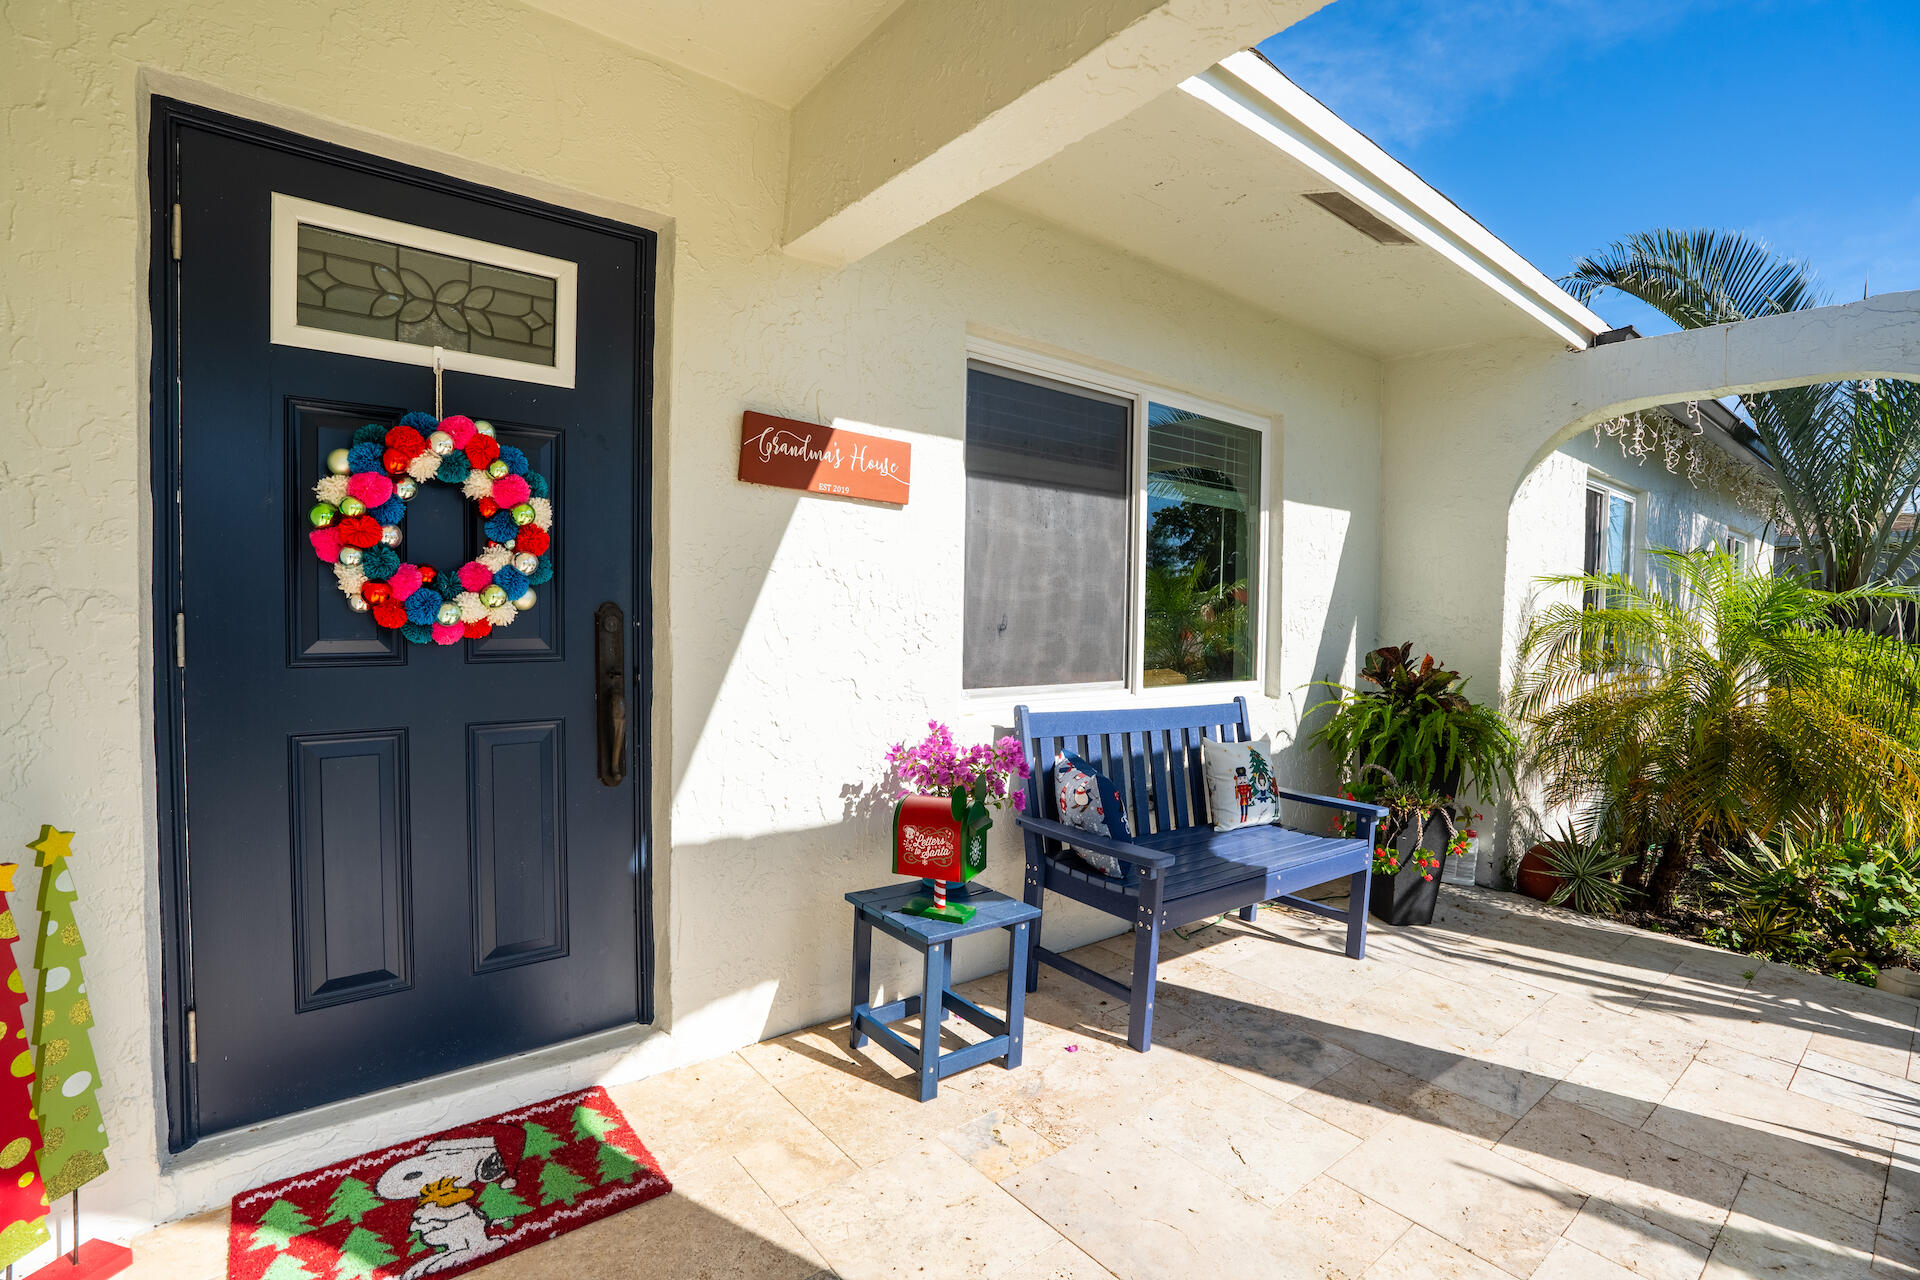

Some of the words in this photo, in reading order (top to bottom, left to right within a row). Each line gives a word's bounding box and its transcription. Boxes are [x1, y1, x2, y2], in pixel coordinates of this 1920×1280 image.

[744, 427, 844, 468] Grandma's
[850, 443, 910, 485] House
[833, 484, 850, 494] 2019
[913, 834, 945, 849] Letters
[914, 847, 921, 855] to
[921, 846, 951, 859] Santa
